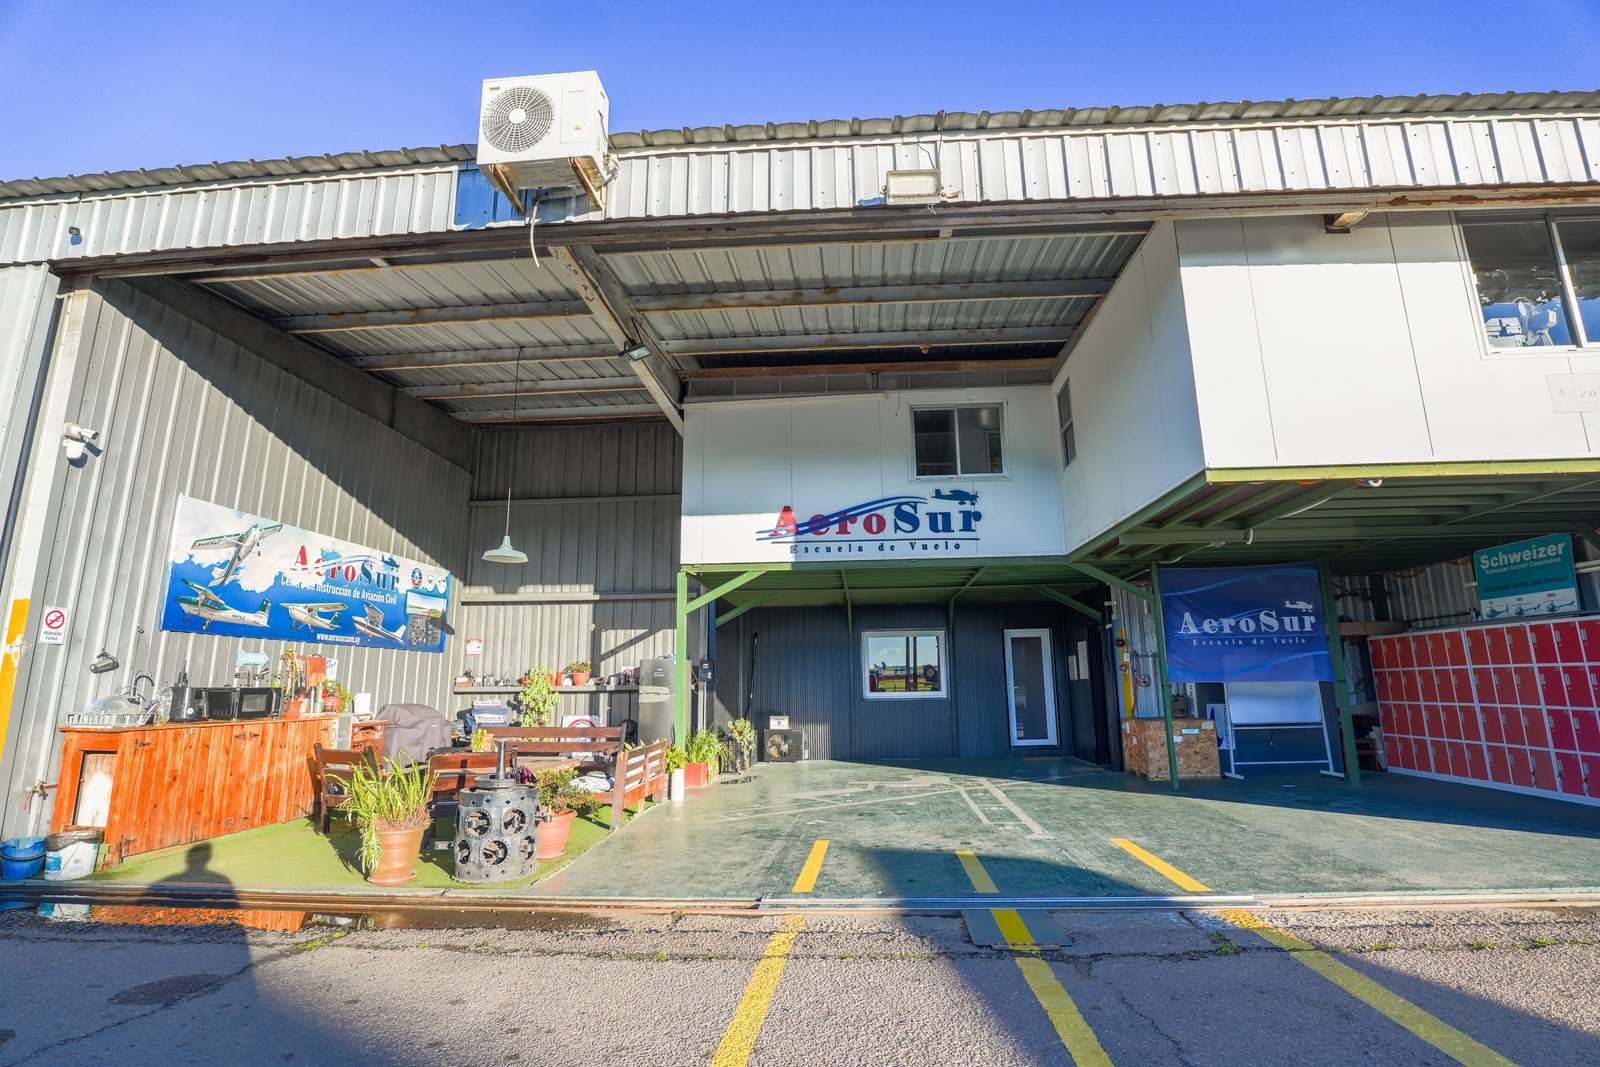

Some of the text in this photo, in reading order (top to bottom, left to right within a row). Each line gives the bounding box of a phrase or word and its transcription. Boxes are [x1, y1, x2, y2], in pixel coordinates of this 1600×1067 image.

[768, 502, 982, 536] AeroSur
[790, 541, 961, 554] Escuela de Vuelo
[1480, 543, 1565, 569] Schweizer
[289, 545, 400, 592] AeroSur
[1543, 575, 1569, 585] Service
[316, 582, 352, 598] Instrucción
[352, 587, 360, 599] de
[361, 588, 384, 603] Aviación
[385, 592, 397, 605] Civil
[1177, 609, 1316, 634] AeroSur
[1193, 637, 1306, 646] Escuela de Vuelo
